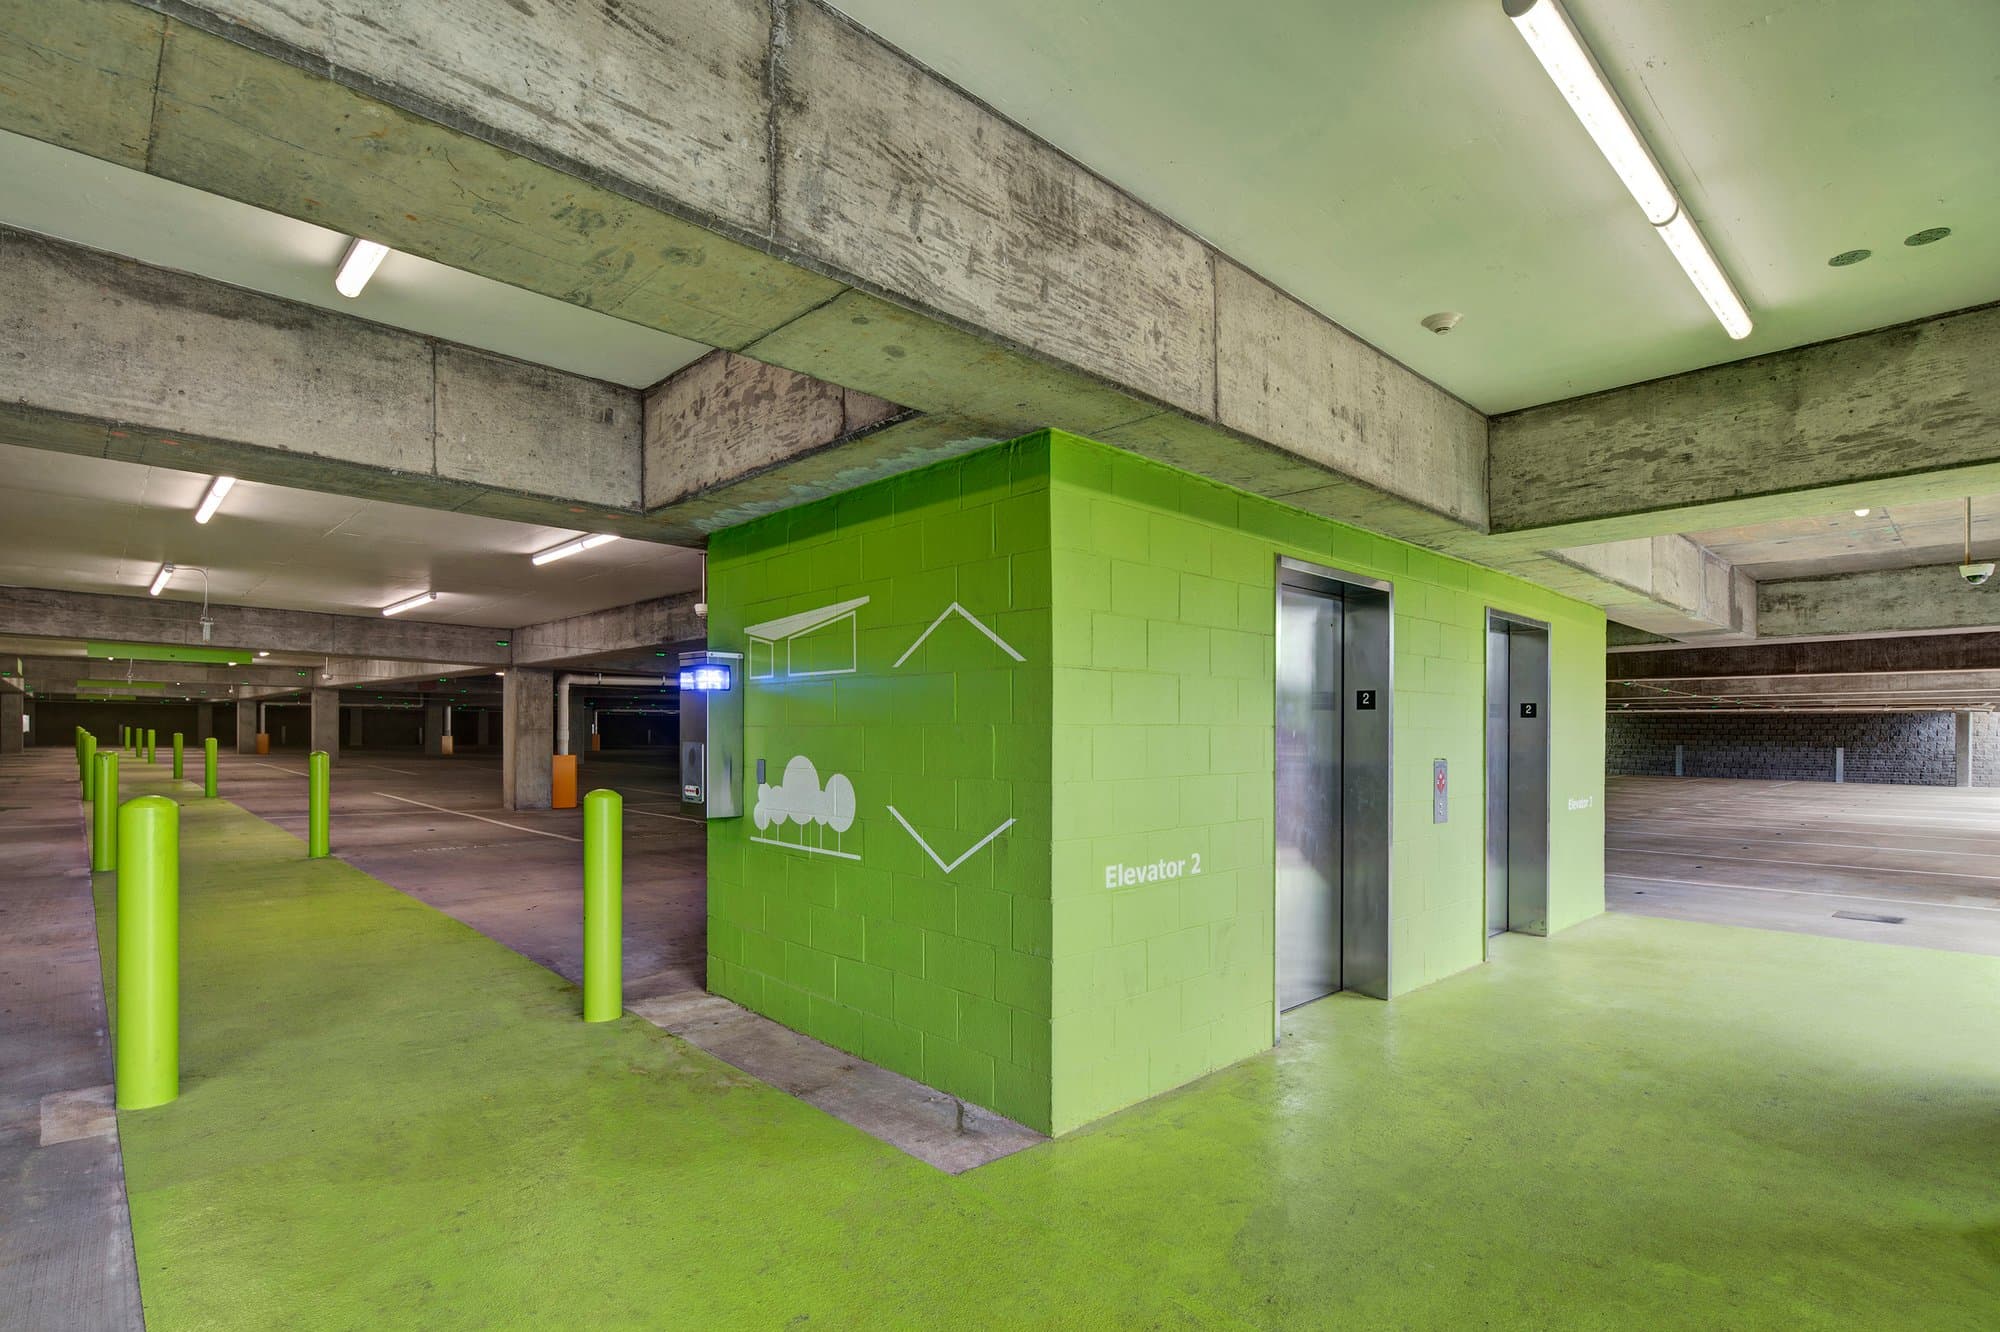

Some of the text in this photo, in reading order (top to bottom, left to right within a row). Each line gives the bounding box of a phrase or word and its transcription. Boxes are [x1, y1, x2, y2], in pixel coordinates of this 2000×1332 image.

[1362, 692, 1370, 704] 2
[1525, 704, 1532, 714] 2
[1105, 852, 1201, 889] Elevator 2
